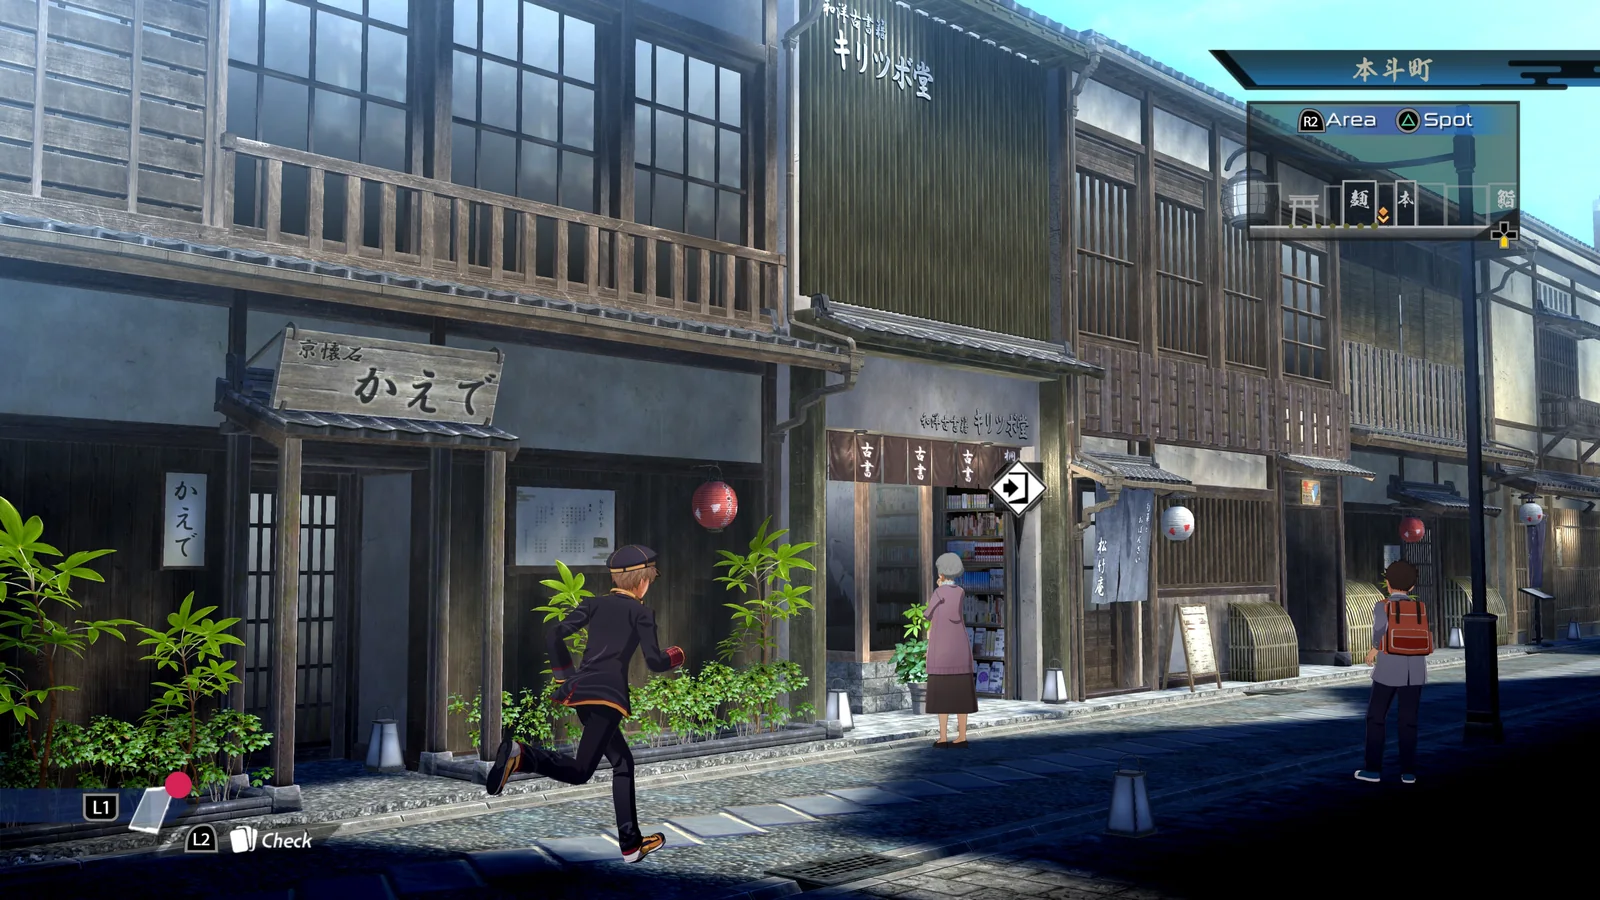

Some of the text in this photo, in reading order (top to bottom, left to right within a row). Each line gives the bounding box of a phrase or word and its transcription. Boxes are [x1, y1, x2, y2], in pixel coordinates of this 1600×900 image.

[823, 0, 886, 40] 和洋古書籍
[834, 29, 934, 101] キリツボ堂
[298, 339, 363, 362] 京懐石
[354, 367, 497, 416] かえで
[973, 408, 1029, 440] キリツボ堂
[860, 442, 875, 478] 古書
[913, 445, 927, 480] 古書
[962, 449, 974, 483] 古書
[174, 480, 198, 557] かえで
[1094, 536, 1107, 596] 松竹庵
